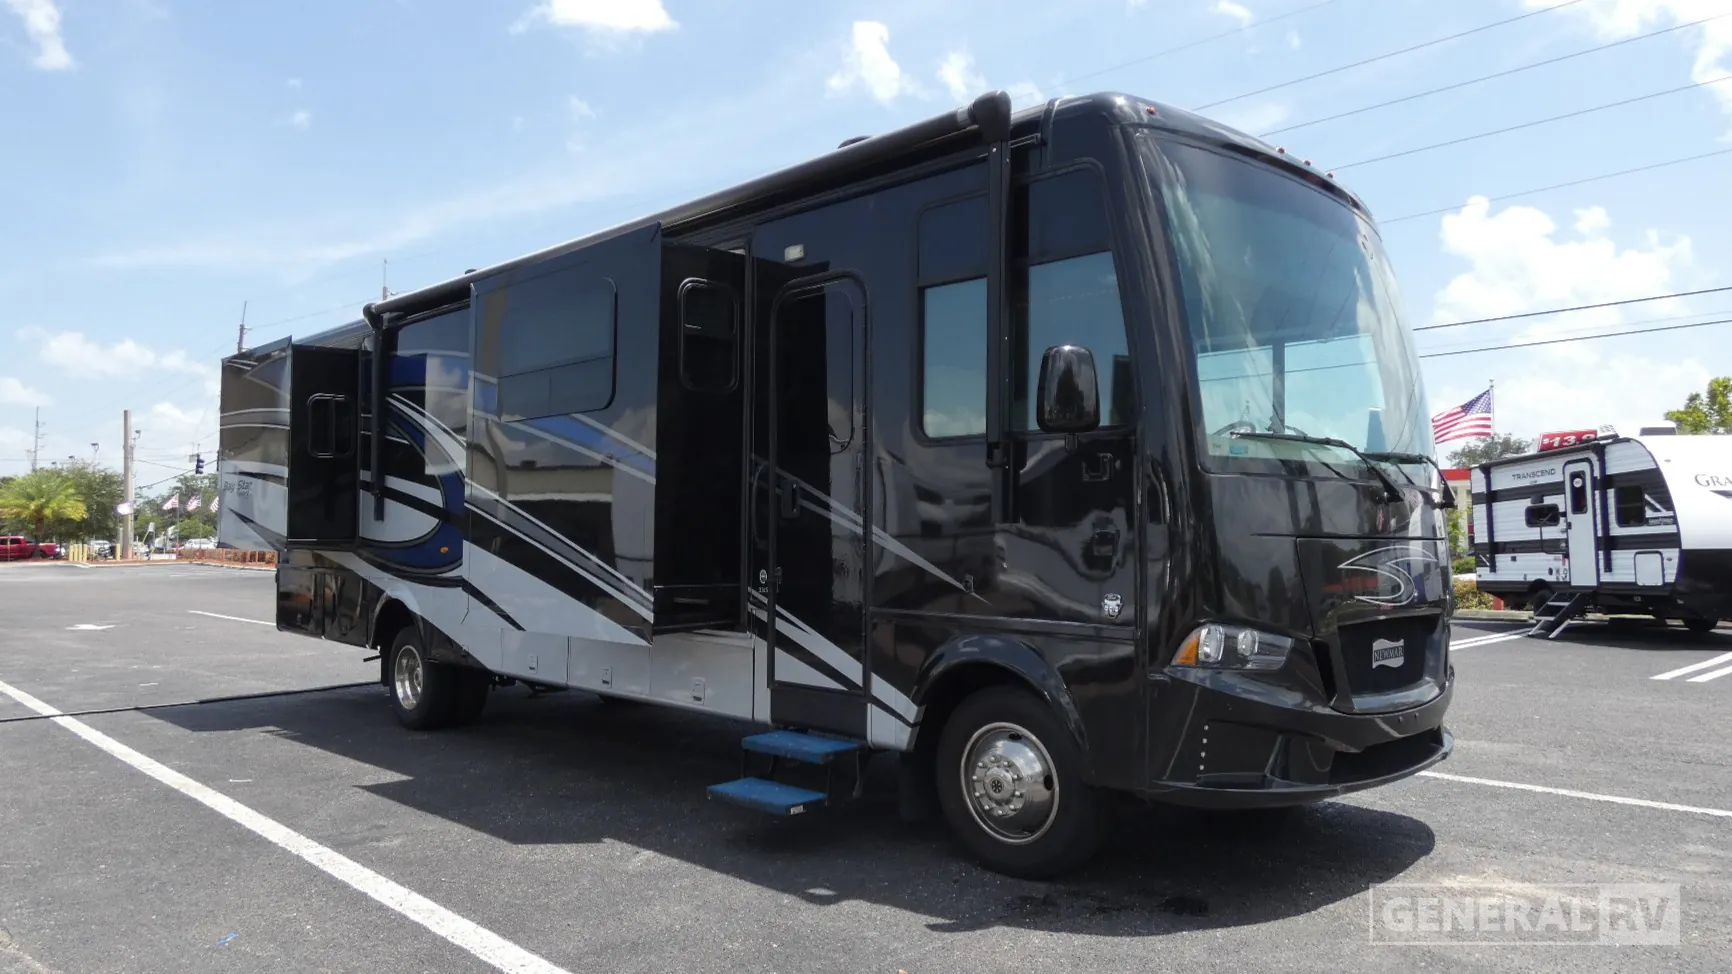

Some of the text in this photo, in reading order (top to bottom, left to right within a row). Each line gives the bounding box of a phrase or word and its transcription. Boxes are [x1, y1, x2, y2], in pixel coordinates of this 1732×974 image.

[1512, 468, 1556, 480] TRANSCEND
[223, 481, 235, 493] Bay
[236, 480, 252, 490] Star
[1375, 647, 1403, 661] NEWMAR
